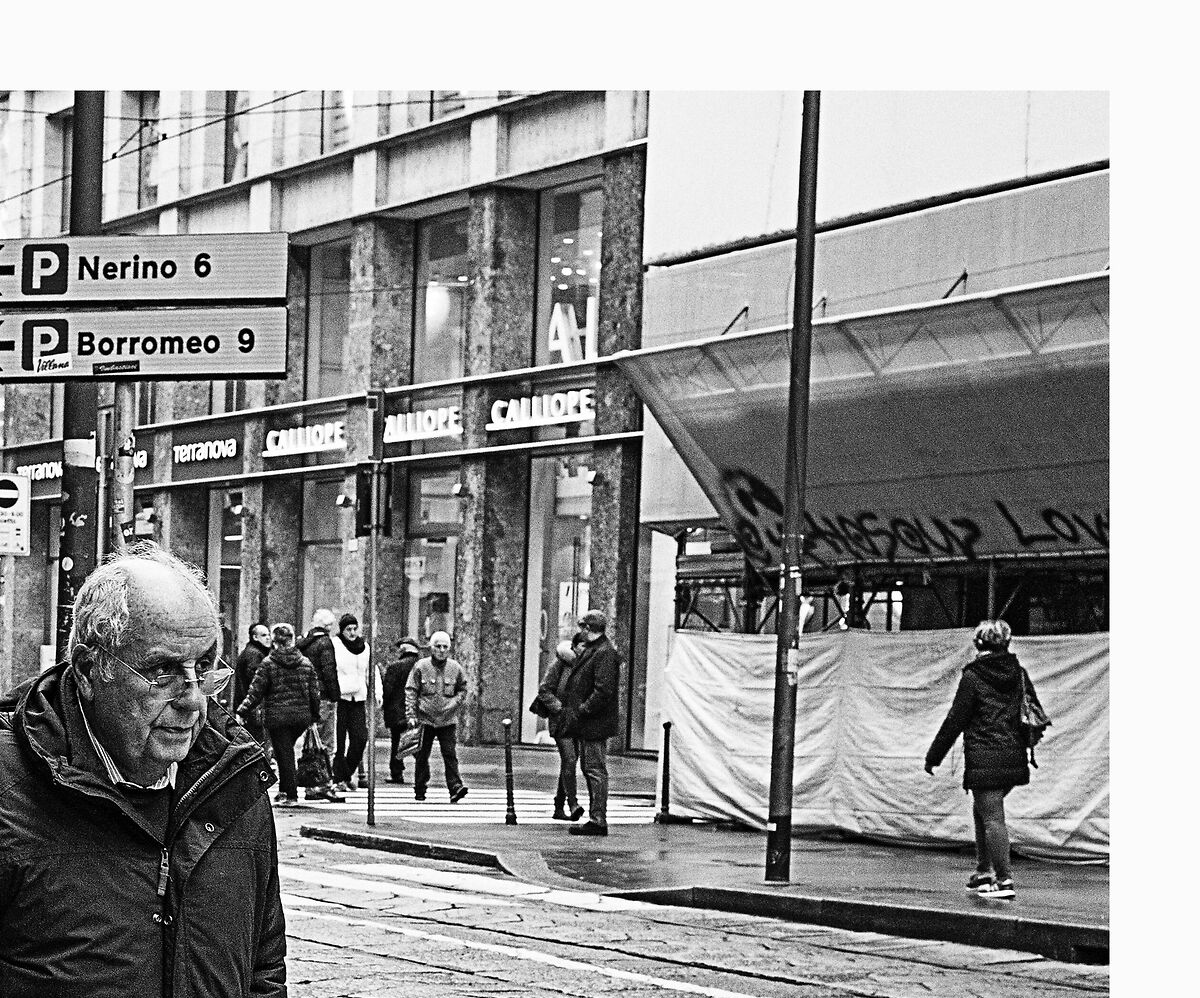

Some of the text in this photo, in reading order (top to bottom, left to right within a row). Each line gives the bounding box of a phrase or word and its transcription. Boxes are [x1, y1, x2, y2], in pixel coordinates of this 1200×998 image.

[78, 254, 178, 281] Nerino
[194, 252, 212, 278] 6
[77, 330, 221, 356] Borromeo
[237, 327, 255, 354] 9
[384, 406, 464, 440] ALLIOPE
[490, 389, 596, 426] CALLIOPE
[265, 421, 347, 453] CALLIOPE
